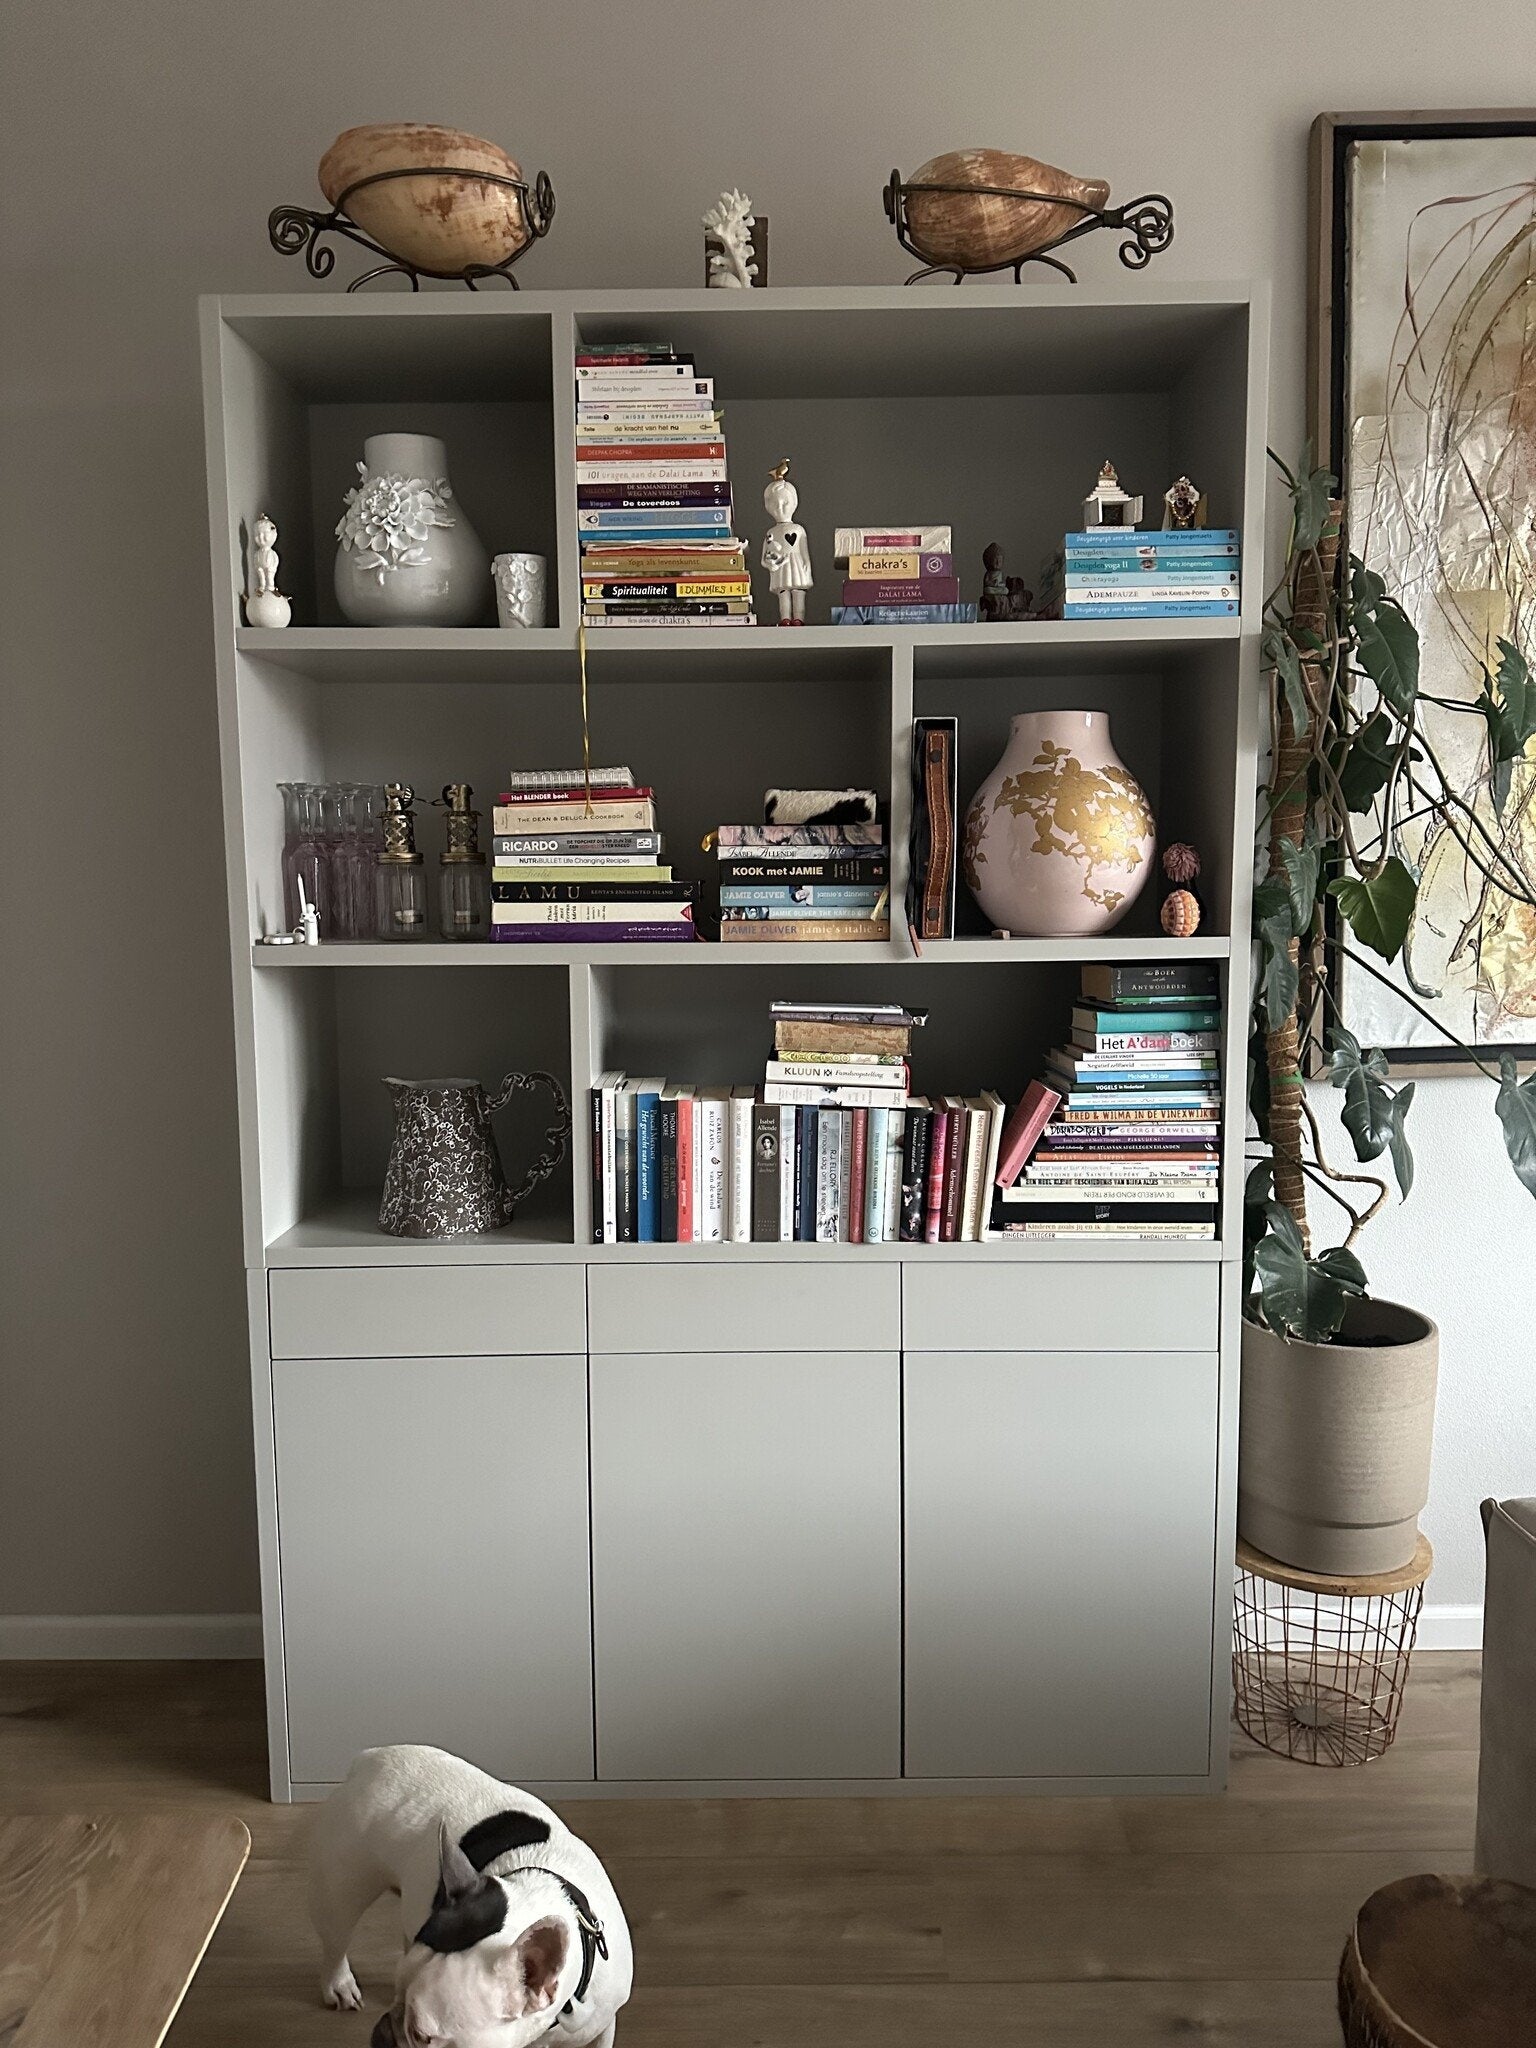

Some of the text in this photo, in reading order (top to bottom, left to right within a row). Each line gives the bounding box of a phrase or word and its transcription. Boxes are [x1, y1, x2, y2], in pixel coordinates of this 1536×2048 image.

[636, 499, 681, 507] toverdoos
[861, 558, 908, 570] chakra's
[612, 585, 668, 596] Spiritualiteit
[1086, 590, 1140, 599] ADEMPAUZE
[501, 840, 559, 852] RICARDO
[574, 857, 606, 866] Changing
[605, 857, 631, 866] Recipes
[732, 867, 764, 876] KOOK
[766, 867, 789, 876] met
[789, 866, 824, 876] JAMIE
[723, 891, 752, 900] JAMIE
[752, 890, 786, 899] OLIVER
[725, 925, 757, 935] JAMIE
[759, 925, 797, 935] OLIVER
[1101, 1037, 1125, 1050] Het
[784, 1066, 821, 1077] KLUUN
[1069, 1111, 1091, 1121] FRED
[1103, 1110, 1132, 1120] WILMA
[1134, 1110, 1145, 1119] IN
[1147, 1110, 1158, 1119] DE
[639, 1110, 650, 1201] Het gewicht van de woorden
